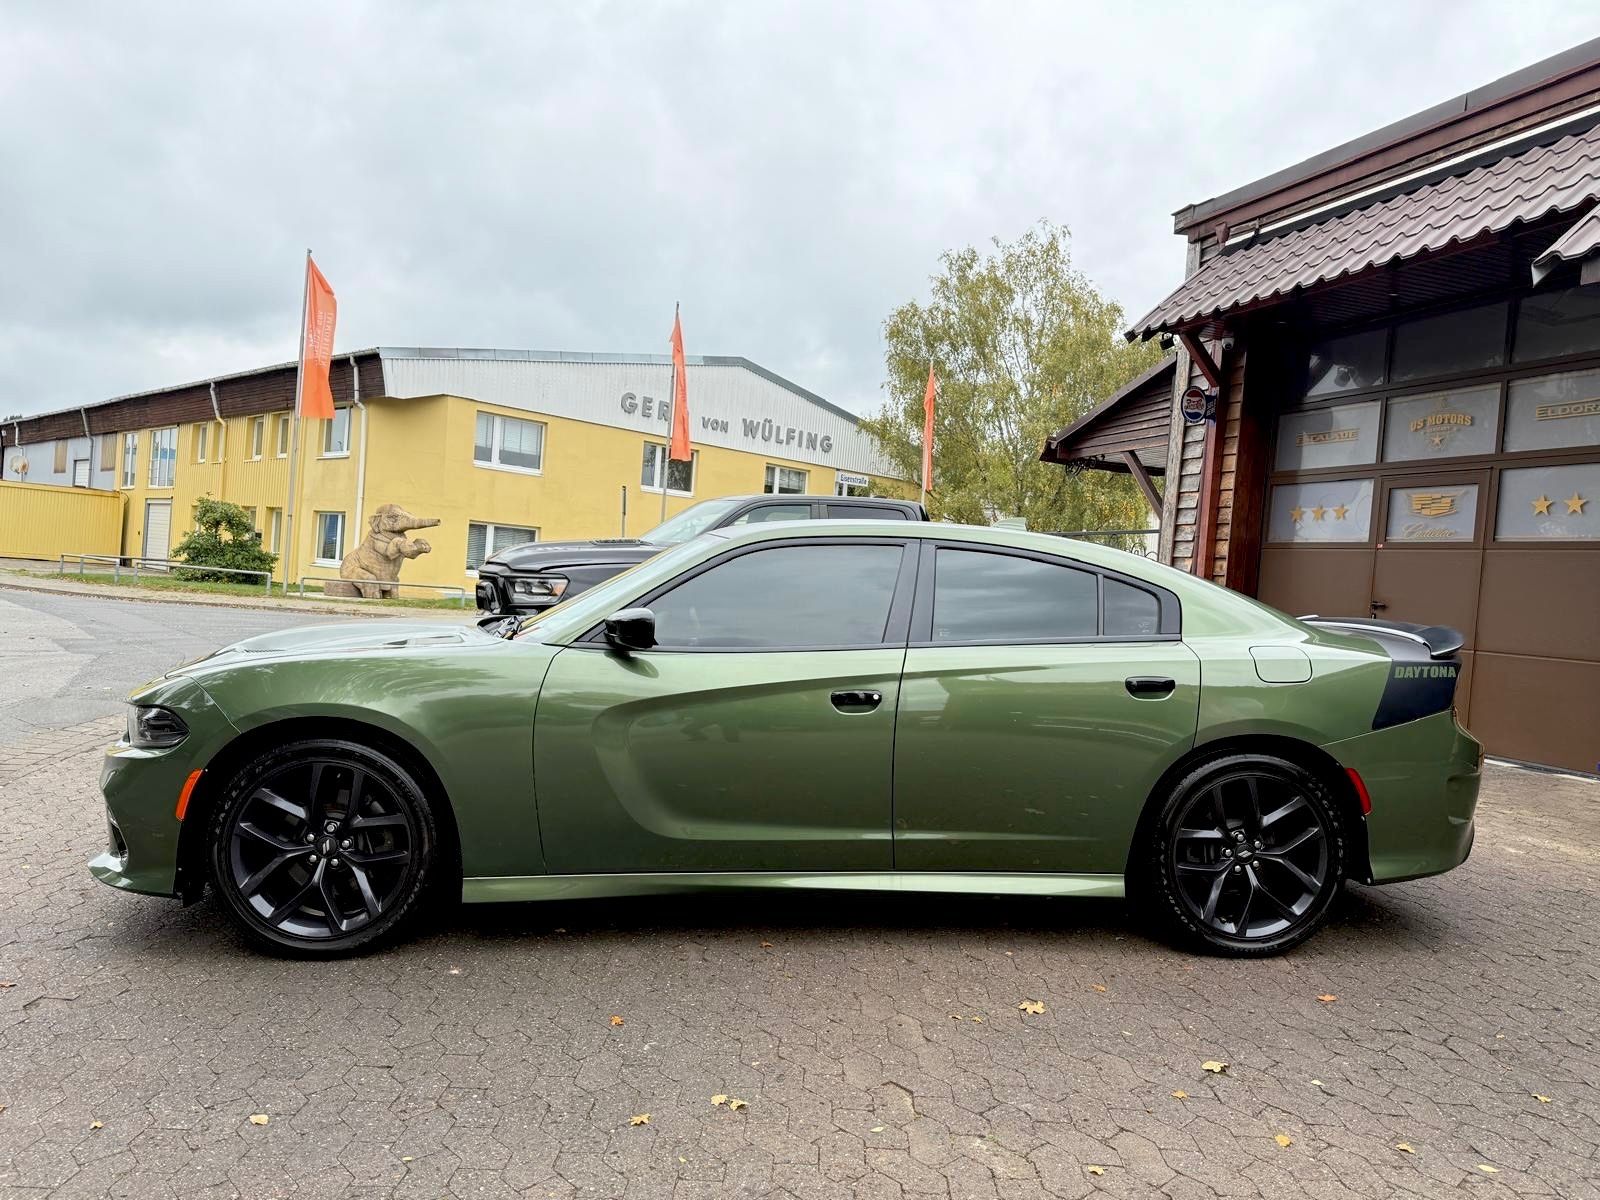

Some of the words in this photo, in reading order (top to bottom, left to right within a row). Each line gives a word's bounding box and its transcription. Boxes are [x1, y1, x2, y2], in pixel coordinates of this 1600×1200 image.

[620, 391, 688, 422] GER
[701, 416, 729, 434] VON
[742, 417, 833, 453] WÜLFING
[1410, 418, 1425, 432] US
[1427, 413, 1473, 426] MOTORS
[1394, 665, 1457, 679] DAYTONA
